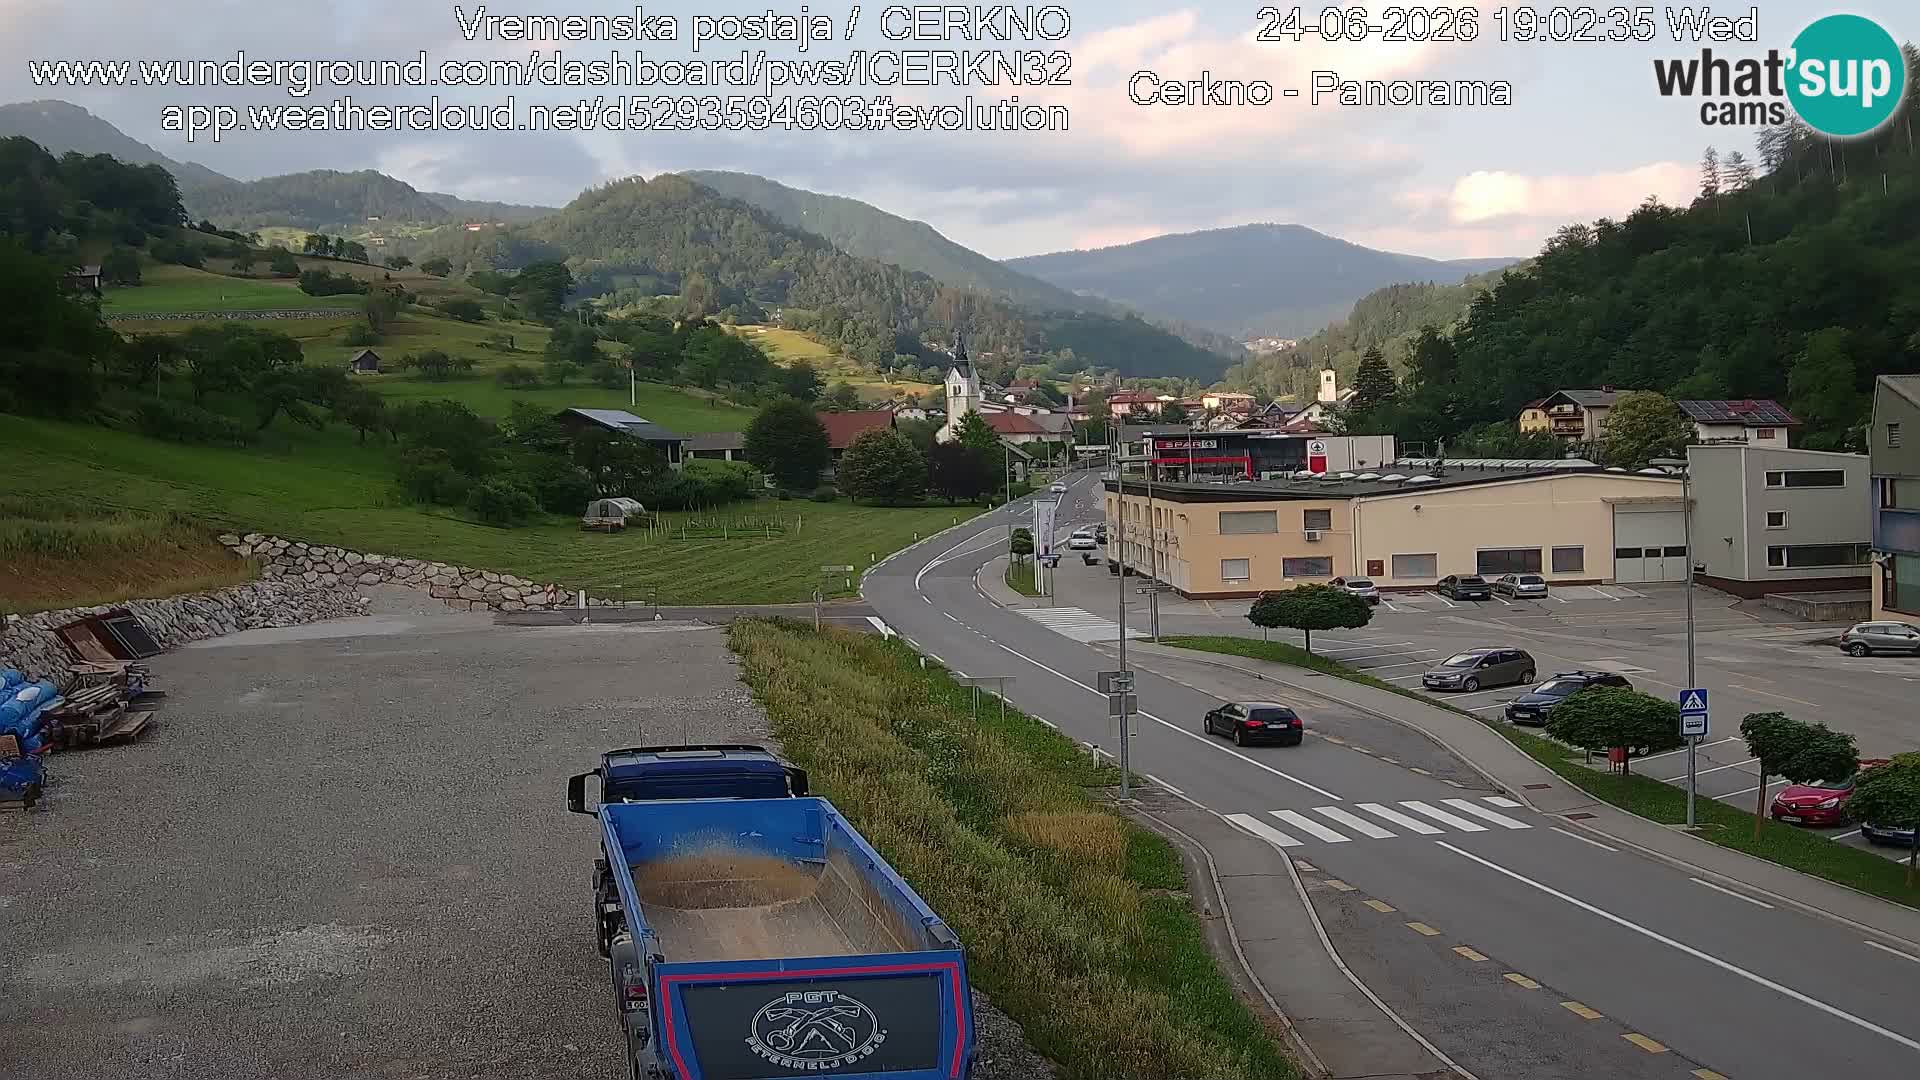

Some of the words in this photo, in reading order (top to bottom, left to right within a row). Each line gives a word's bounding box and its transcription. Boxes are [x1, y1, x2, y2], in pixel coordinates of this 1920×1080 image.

[1165, 441, 1202, 449] SPAR
[786, 991, 838, 1004] PGT
[745, 1036, 840, 1070] PETERNELJ
